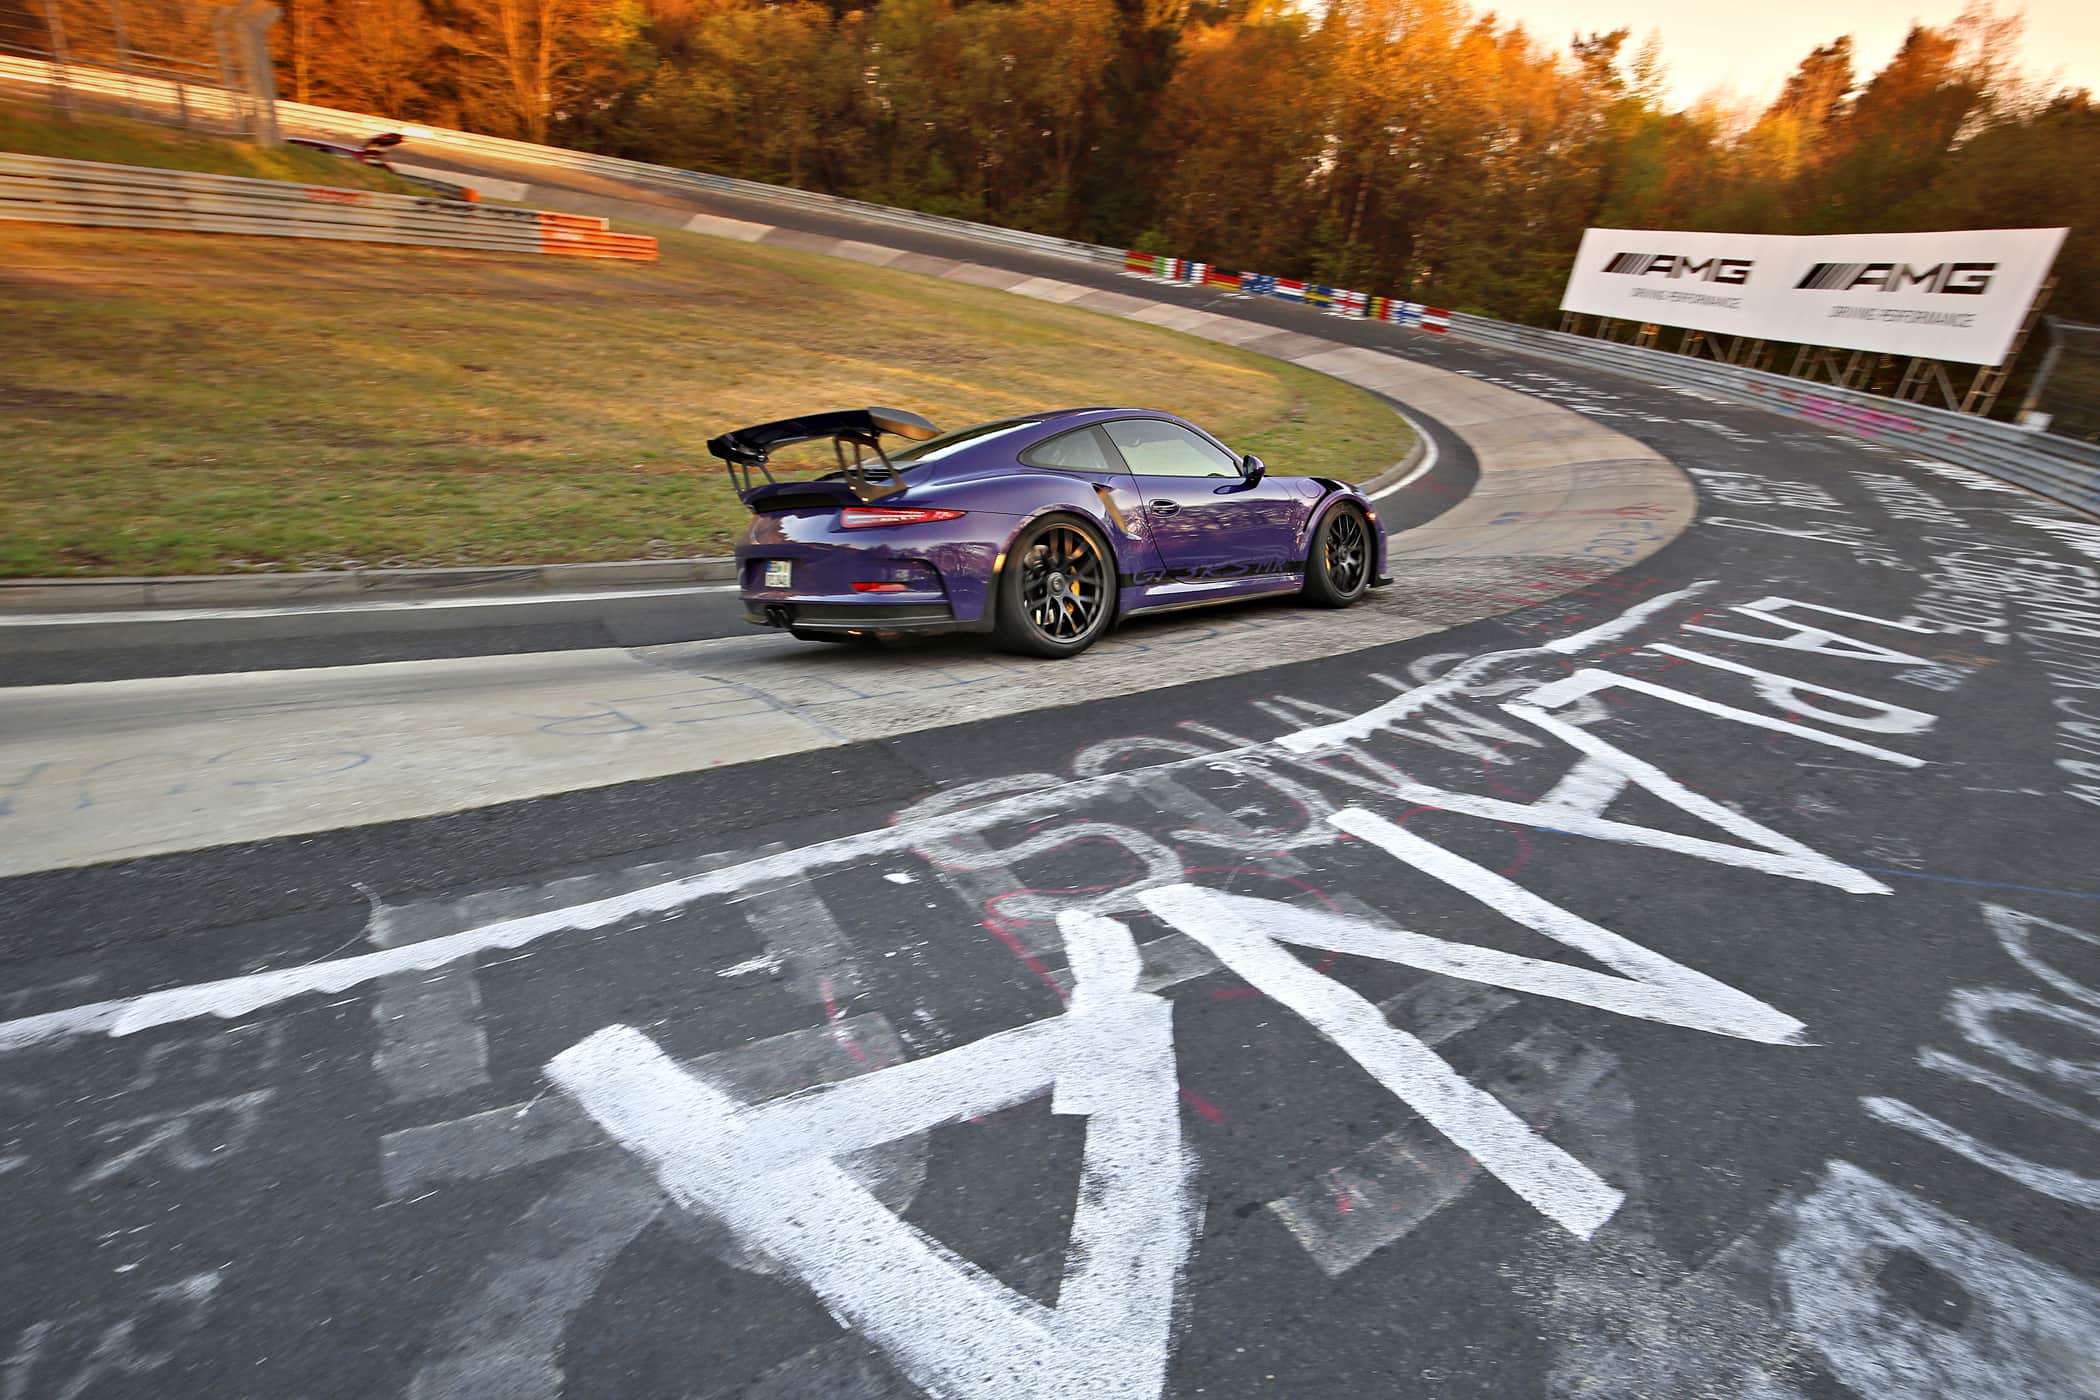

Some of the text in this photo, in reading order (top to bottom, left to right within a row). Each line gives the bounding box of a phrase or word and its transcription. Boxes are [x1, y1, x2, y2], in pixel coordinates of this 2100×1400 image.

[1636, 254, 1755, 285] AMG
[1842, 263, 2000, 295] AMG
[1879, 308, 1977, 328] PERFORMANCE
